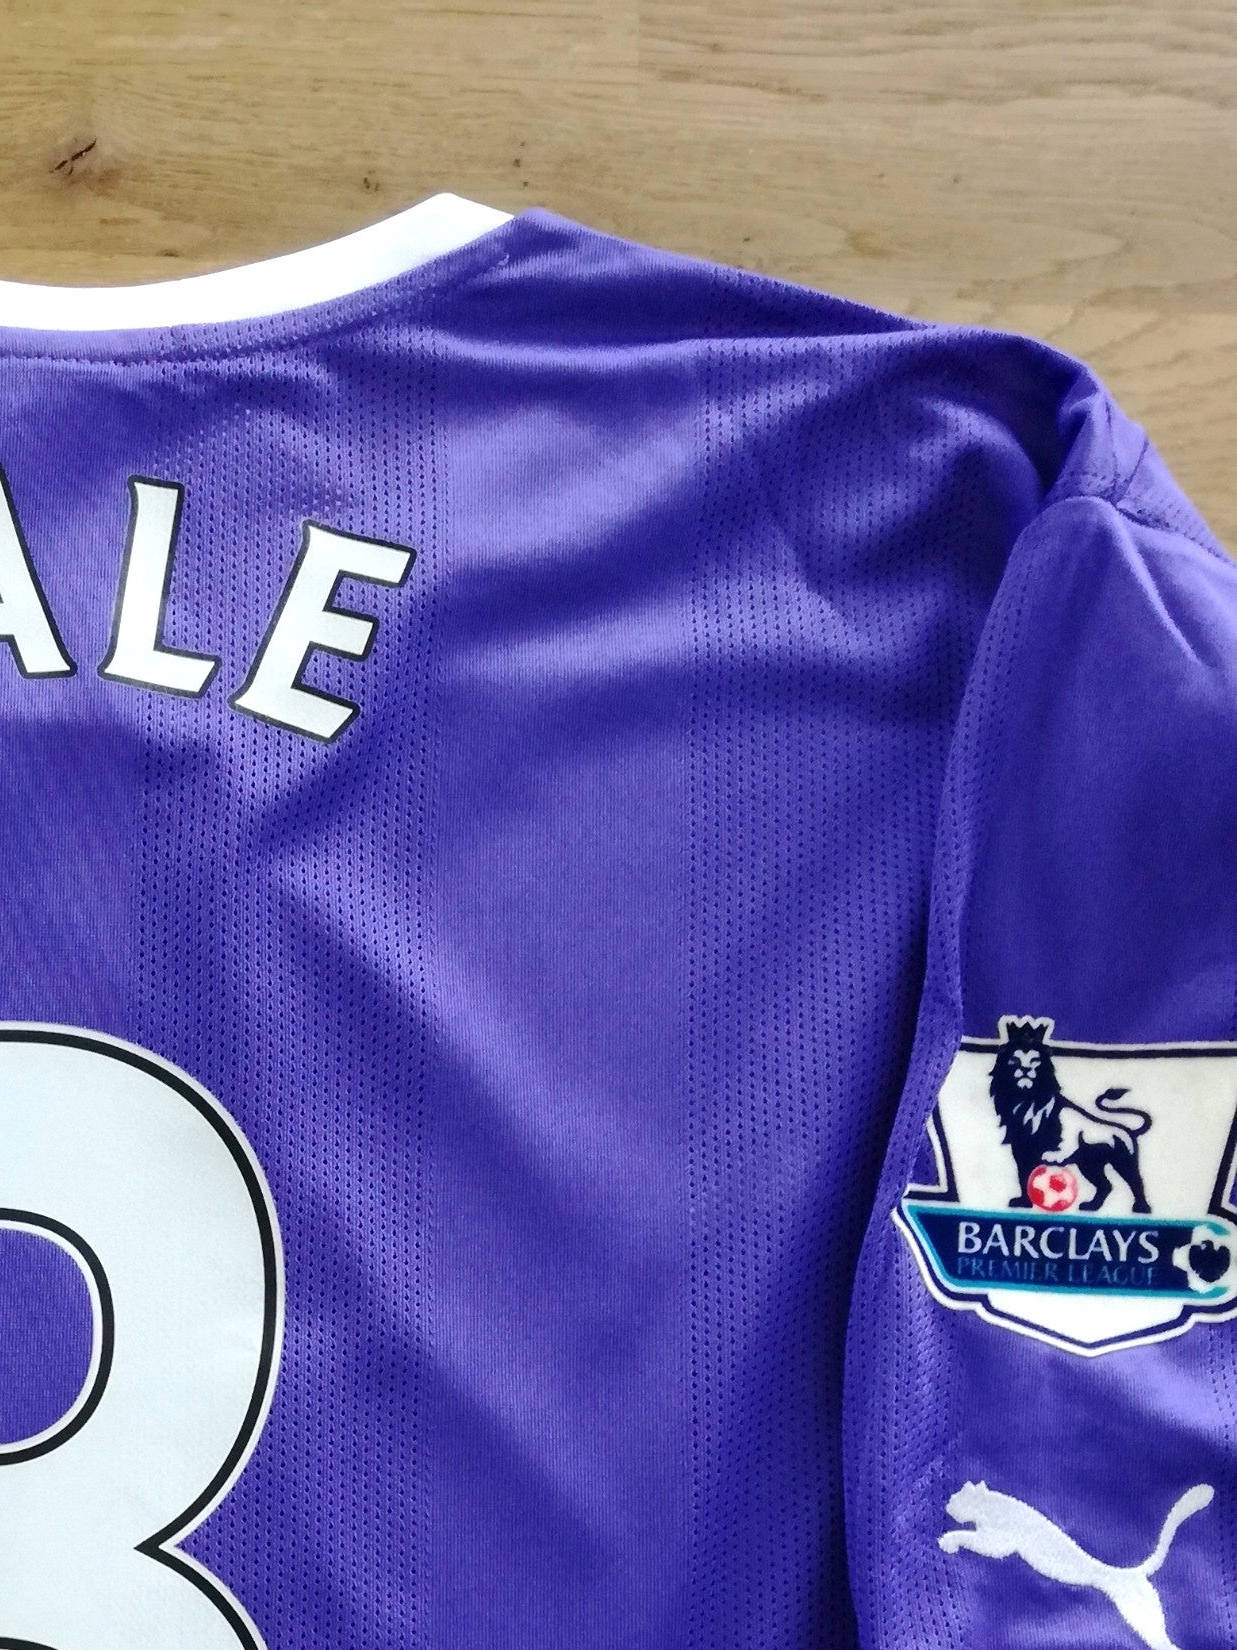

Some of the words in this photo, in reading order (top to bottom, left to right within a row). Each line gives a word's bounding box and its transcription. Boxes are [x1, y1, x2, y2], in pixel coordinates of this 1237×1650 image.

[957, 1221, 1160, 1264] BARCLAYS
[956, 1256, 1059, 1282] PREMIER
[1068, 1262, 1158, 1286] LEAGUE
